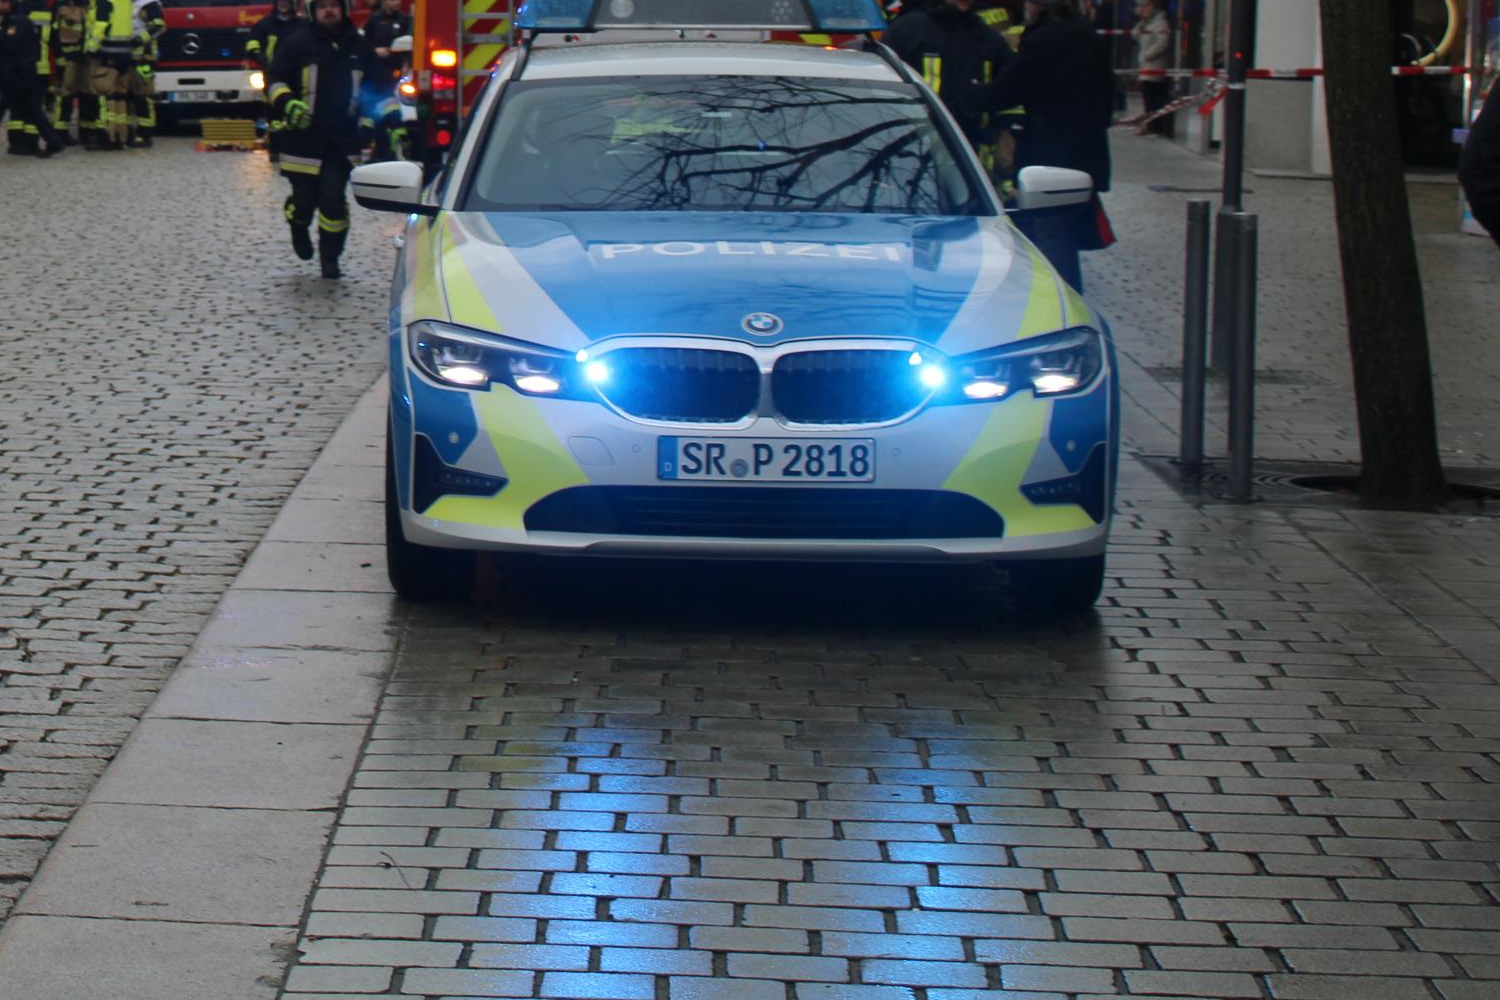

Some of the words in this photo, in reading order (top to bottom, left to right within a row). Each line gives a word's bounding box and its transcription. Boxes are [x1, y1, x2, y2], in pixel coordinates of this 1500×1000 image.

[602, 241, 900, 262] POLIZEI
[682, 442, 726, 476] SR
[753, 443, 774, 475] P
[782, 445, 869, 477] 2818
